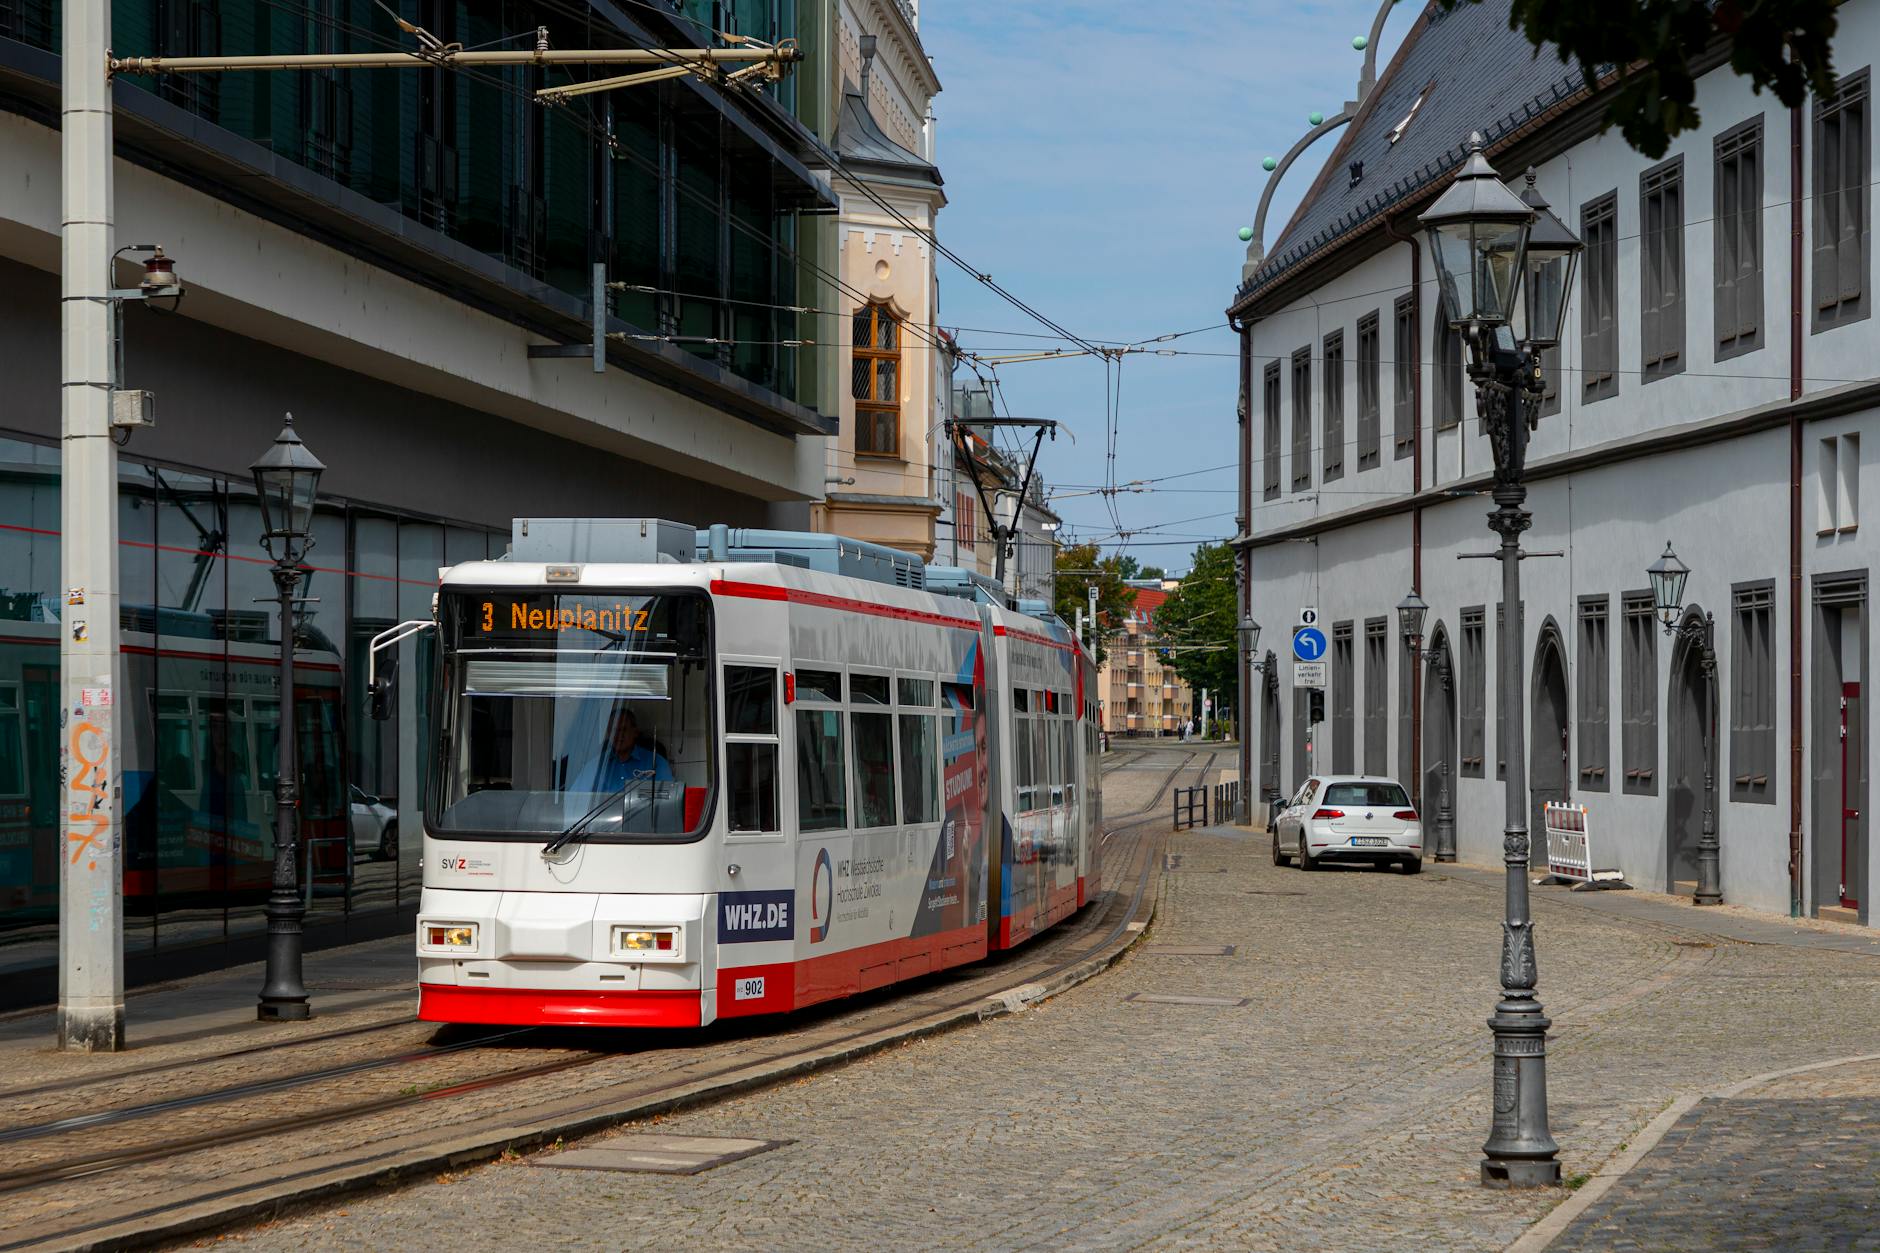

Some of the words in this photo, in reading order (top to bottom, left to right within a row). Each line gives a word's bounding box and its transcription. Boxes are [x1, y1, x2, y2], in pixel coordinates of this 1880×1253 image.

[1090, 588, 1097, 599] E
[482, 602, 494, 632] 3
[511, 602, 648, 632] Neuplanitz
[1297, 671, 1322, 679] verkehr
[837, 860, 850, 877] WHZ
[837, 884, 863, 904] Hochschule
[863, 881, 881, 900] Zwickau
[724, 902, 788, 931] WHZ.DE
[745, 980, 763, 996] 902
